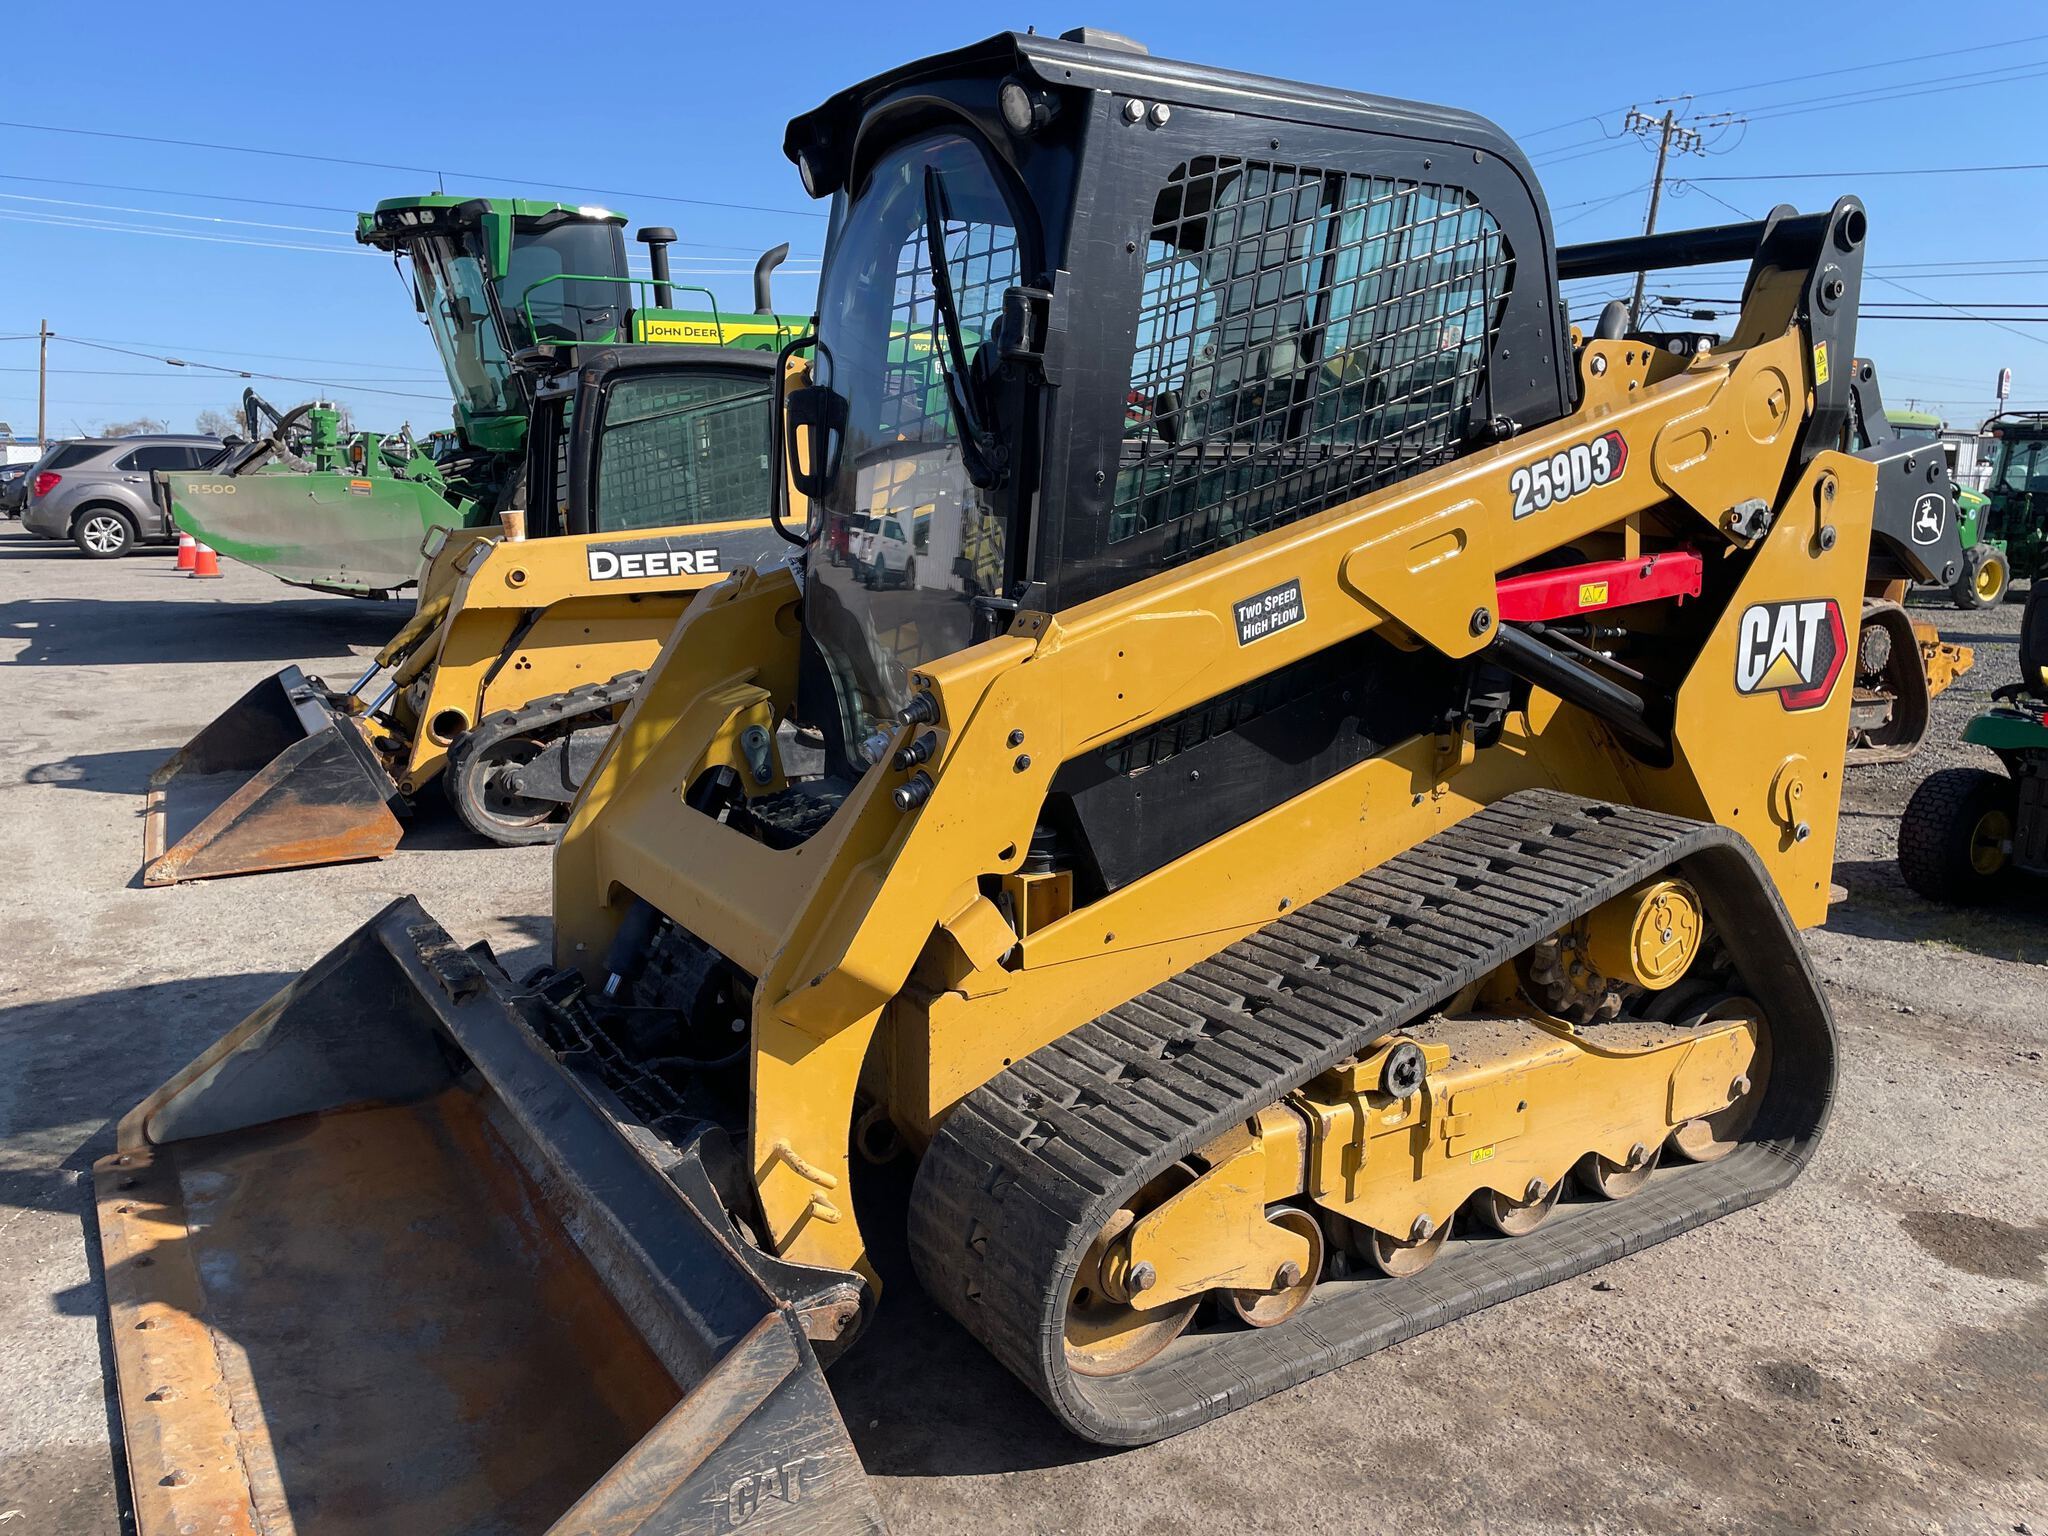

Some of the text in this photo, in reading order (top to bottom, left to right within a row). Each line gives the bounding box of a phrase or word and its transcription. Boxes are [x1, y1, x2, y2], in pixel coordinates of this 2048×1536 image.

[648, 325, 681, 336] JOHN
[1511, 437, 1611, 518] 259D3
[588, 549, 719, 580] DEERE
[1238, 587, 1297, 622] TWO SPEED
[1243, 605, 1299, 641] HIGH FLOW
[1737, 601, 1827, 692] CAT
[728, 1457, 806, 1527] CAT
